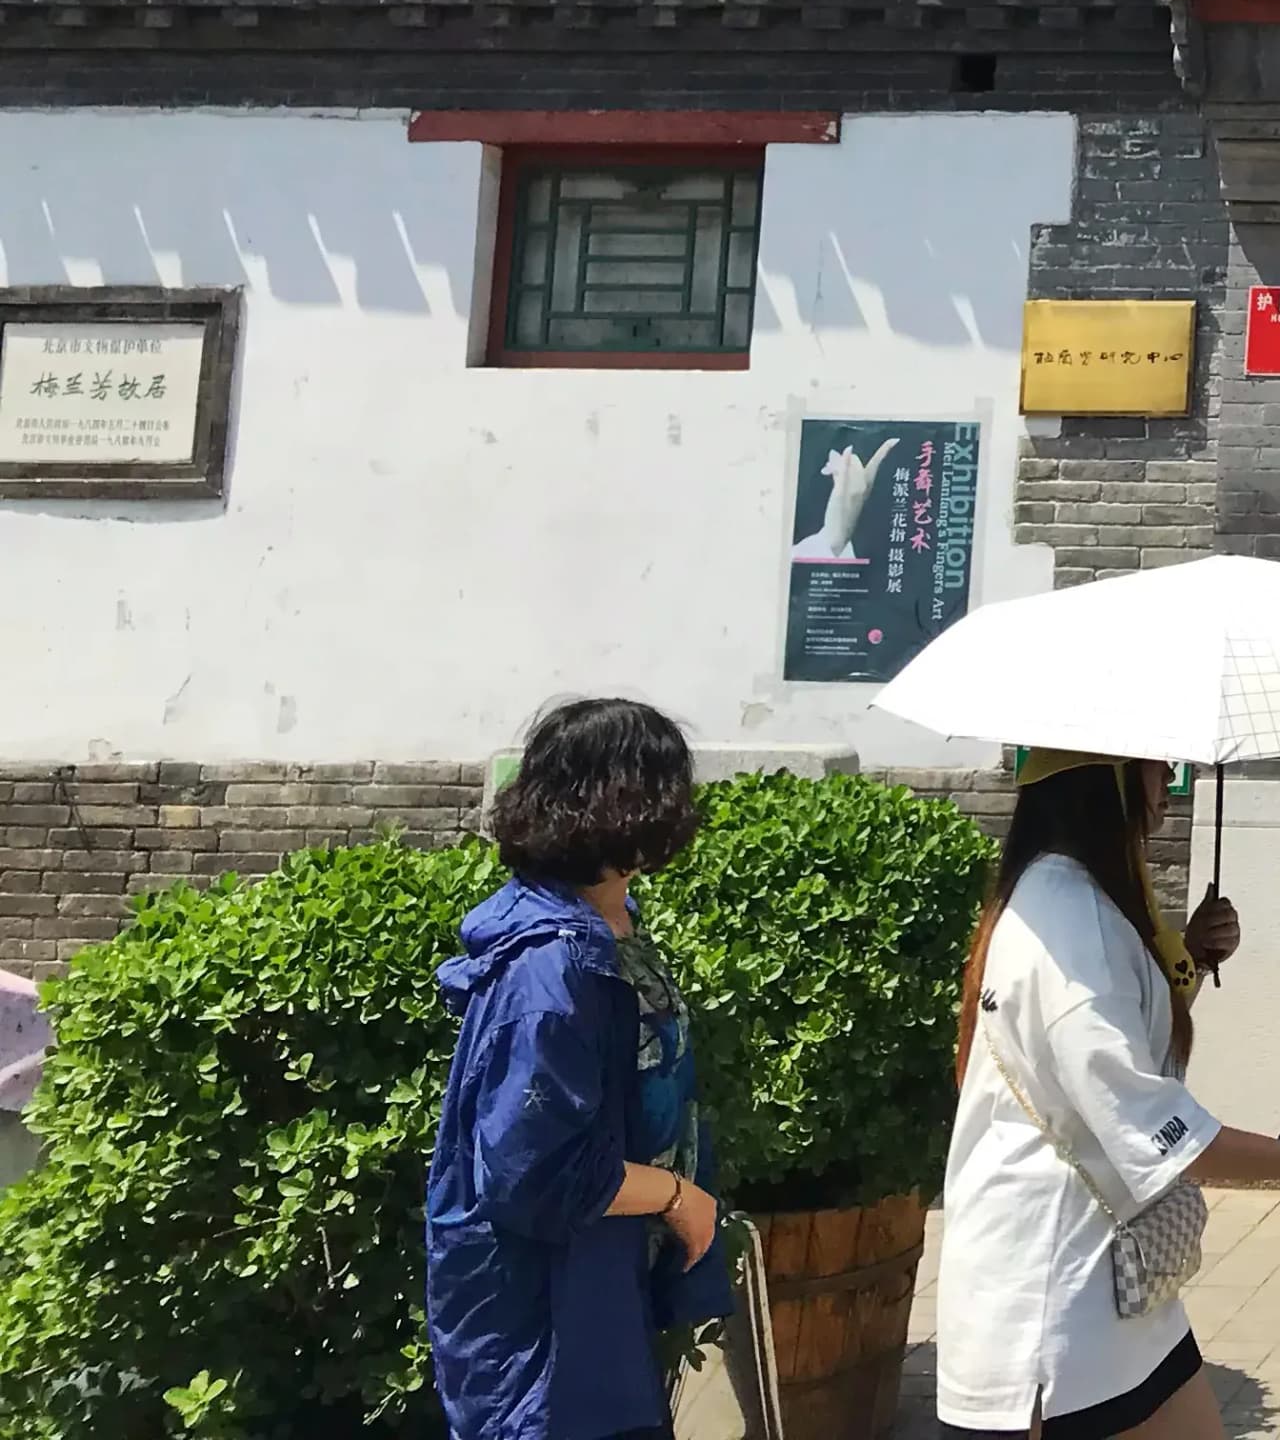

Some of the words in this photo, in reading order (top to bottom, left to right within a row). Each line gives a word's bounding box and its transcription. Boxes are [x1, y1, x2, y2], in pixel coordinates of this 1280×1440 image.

[42, 337, 163, 354] 北京市文物保护单位
[30, 369, 168, 401] 梅兰芳故居
[942, 441, 957, 466] Mei
[889, 467, 911, 542] 梅派兰花指
[945, 423, 978, 589] Exhibition
[885, 548, 905, 593] 摄影展
[932, 542, 948, 595] Fingers
[931, 597, 945, 620] Art
[1159, 1115, 1190, 1149] NBA
